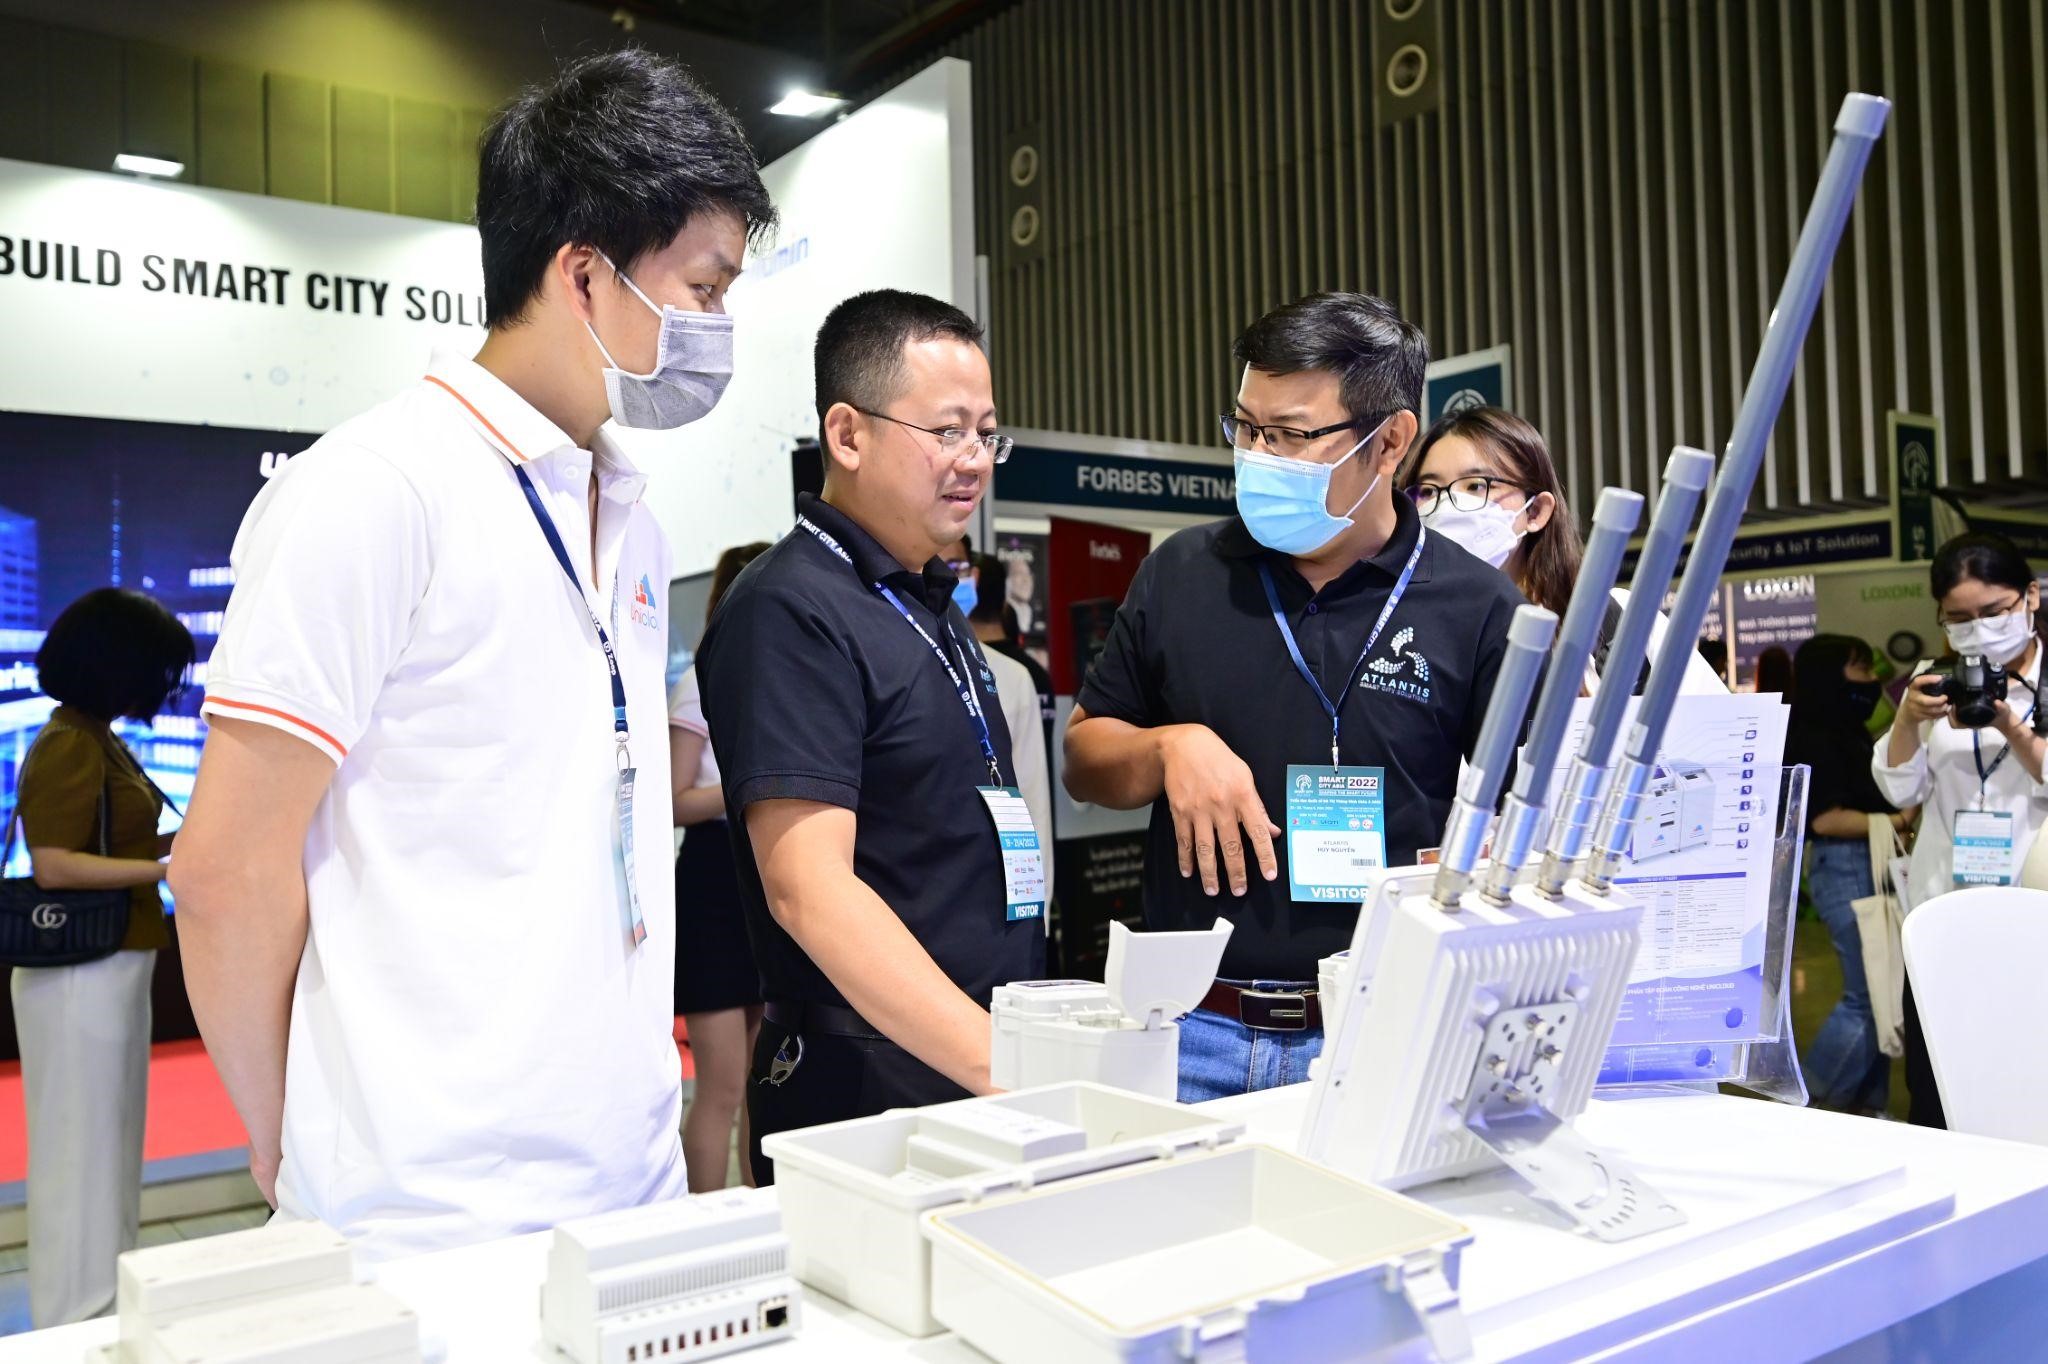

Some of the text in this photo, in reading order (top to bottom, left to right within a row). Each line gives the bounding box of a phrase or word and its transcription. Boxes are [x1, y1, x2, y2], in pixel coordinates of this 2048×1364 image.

[0, 235, 121, 287] BUILD
[142, 254, 290, 305] SMART
[307, 272, 389, 317] CITY
[1077, 465, 1236, 499] FORBES VIETNA
[819, 532, 838, 550] CITY
[1775, 542, 1785, 555] &
[1789, 539, 1811, 552] IoT
[1818, 532, 1880, 550] Solution
[1861, 584, 1923, 601] LOXONE
[936, 648, 950, 667] CITY
[1361, 672, 1430, 698] ATLANTIS
[1349, 778, 1377, 787] 2022
[1963, 875, 2000, 884] VISITOR
[1311, 886, 1368, 899] VISITOR
[1014, 905, 1039, 918] VISITOR
